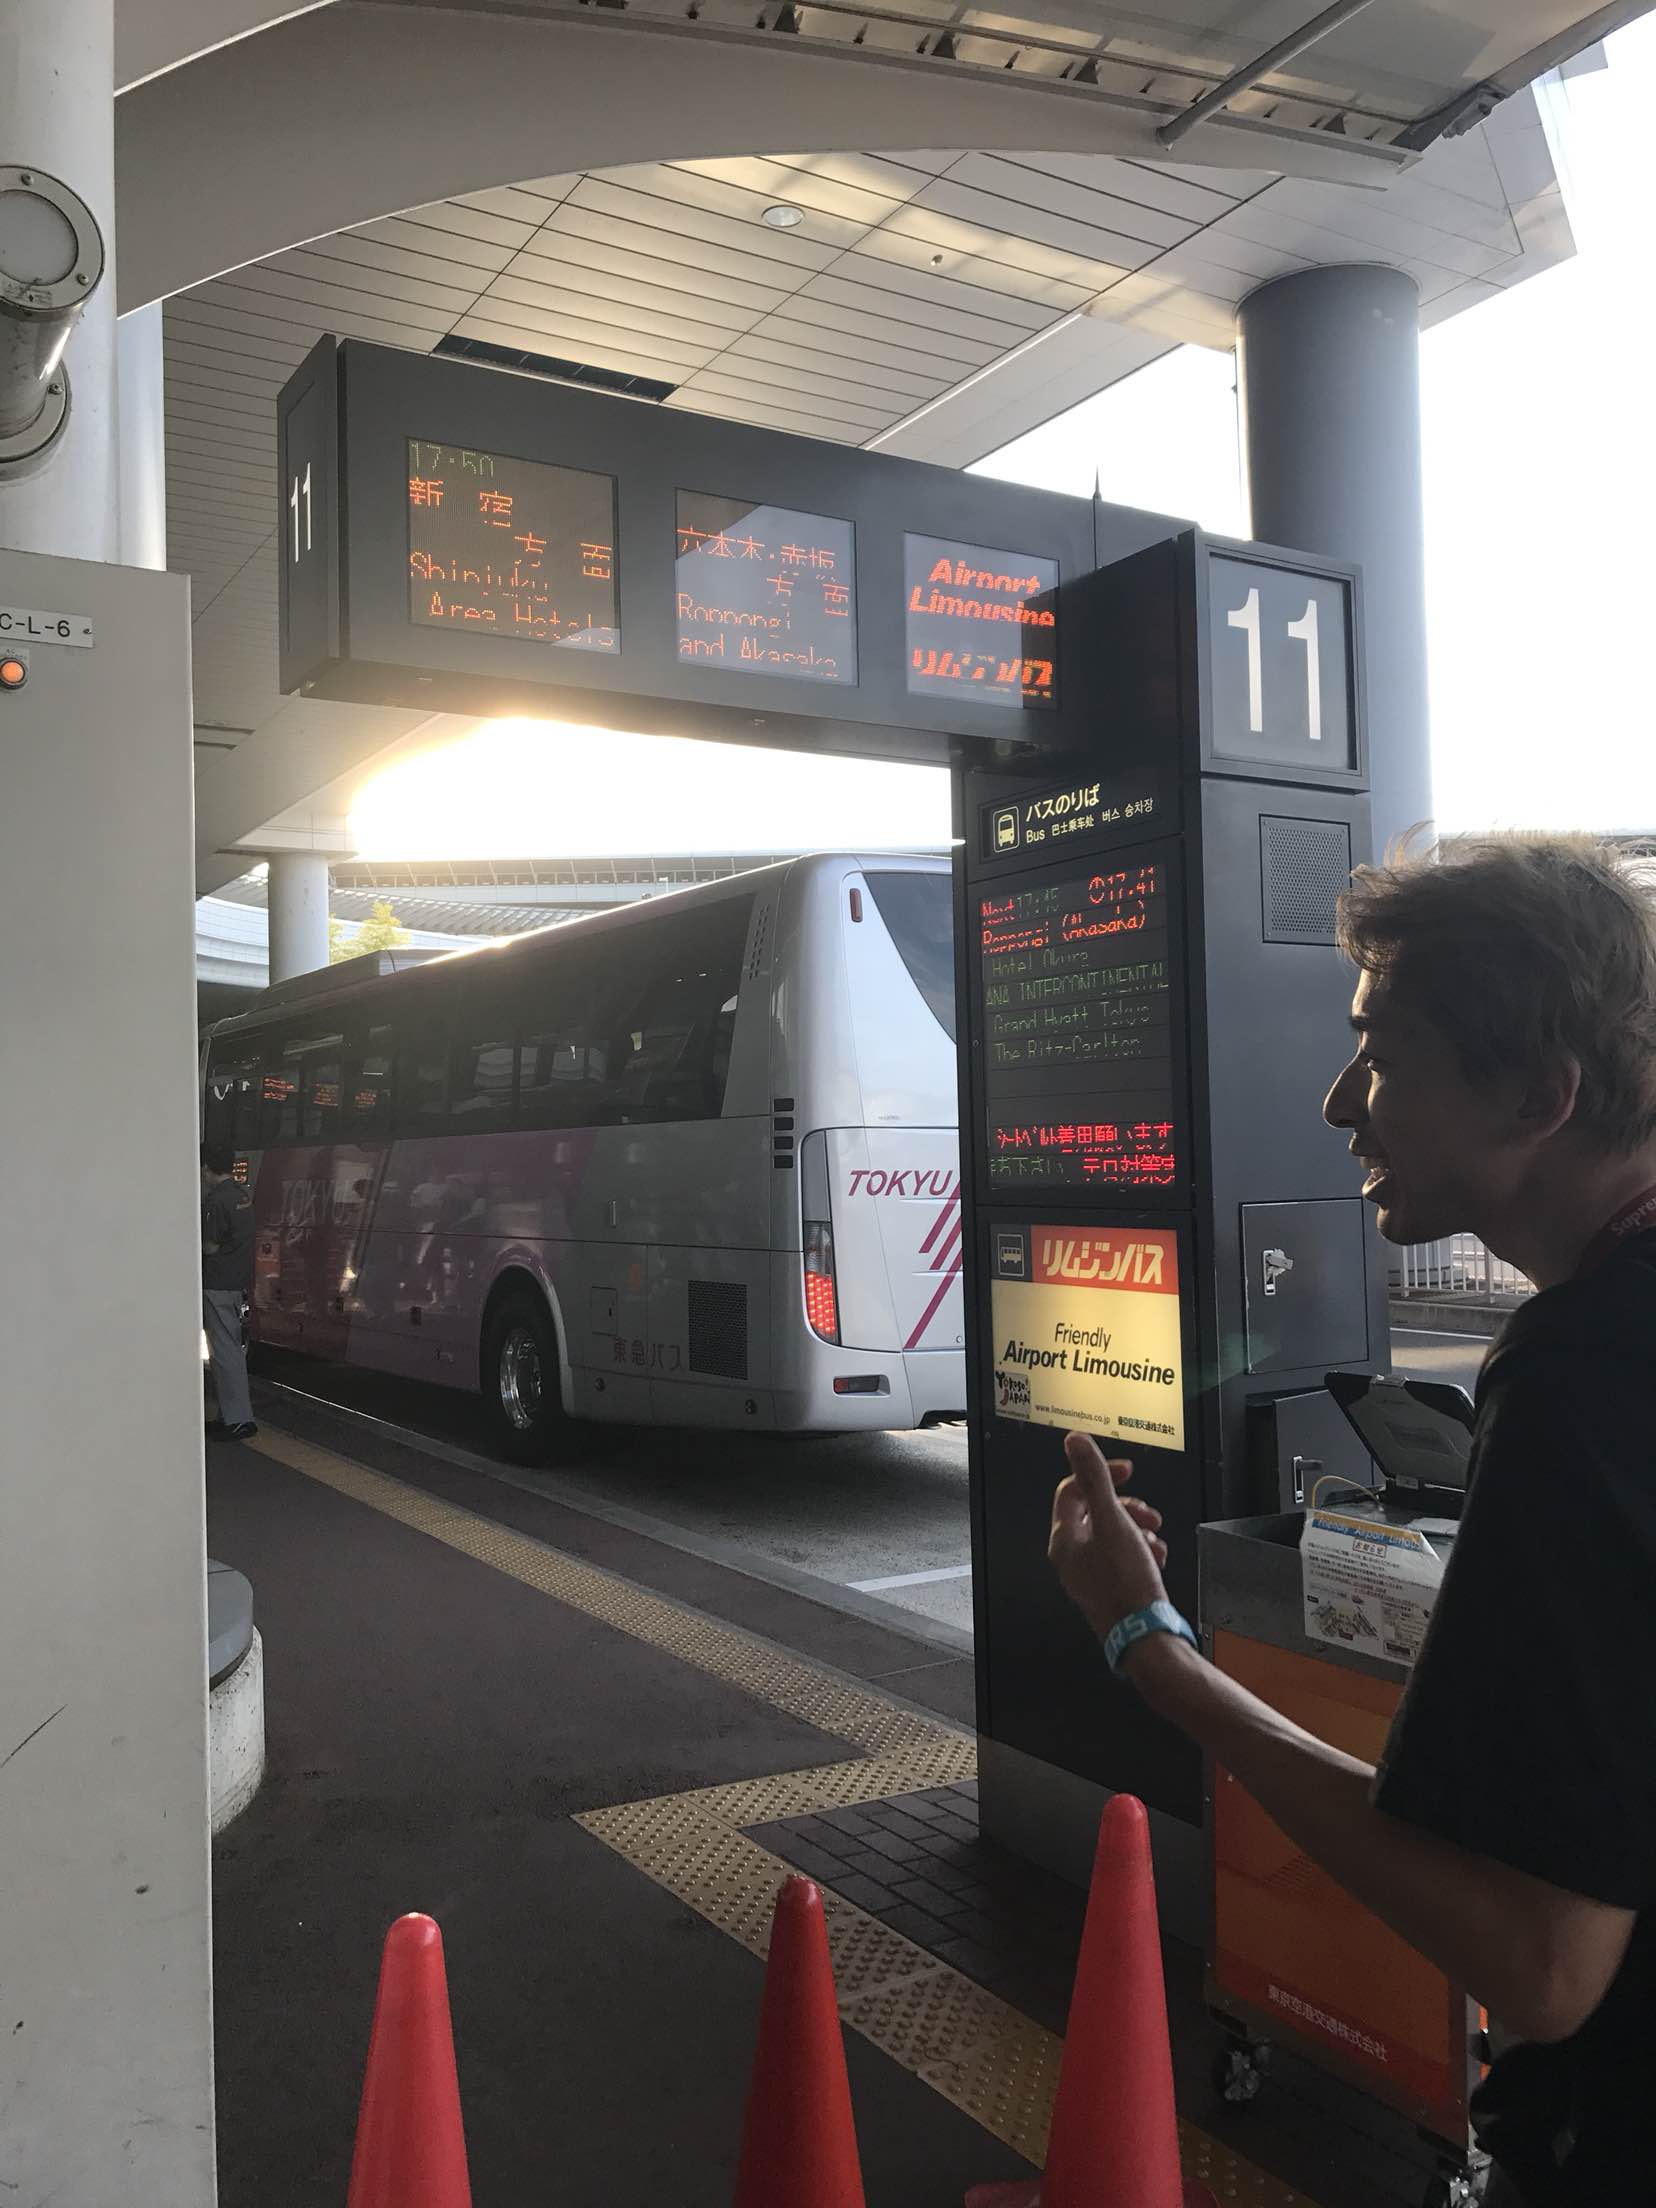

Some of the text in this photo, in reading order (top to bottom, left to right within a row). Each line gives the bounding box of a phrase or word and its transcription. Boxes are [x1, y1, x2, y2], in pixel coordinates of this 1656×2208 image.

[290, 462, 311, 563] 11
[928, 559, 1041, 594] Airport
[909, 585, 1055, 627] Limousine
[679, 633, 725, 657] and
[1228, 588, 1321, 741] 11
[1026, 783, 1101, 822] バスのりば
[1026, 829, 1046, 844] Bus
[1102, 809, 1121, 823] 버스
[847, 1170, 954, 1196] TOKYU
[1042, 1239, 1165, 1285] リムジンバス
[1054, 1322, 1112, 1353] Friendly
[1003, 1340, 1175, 1386] Airport Limousine
